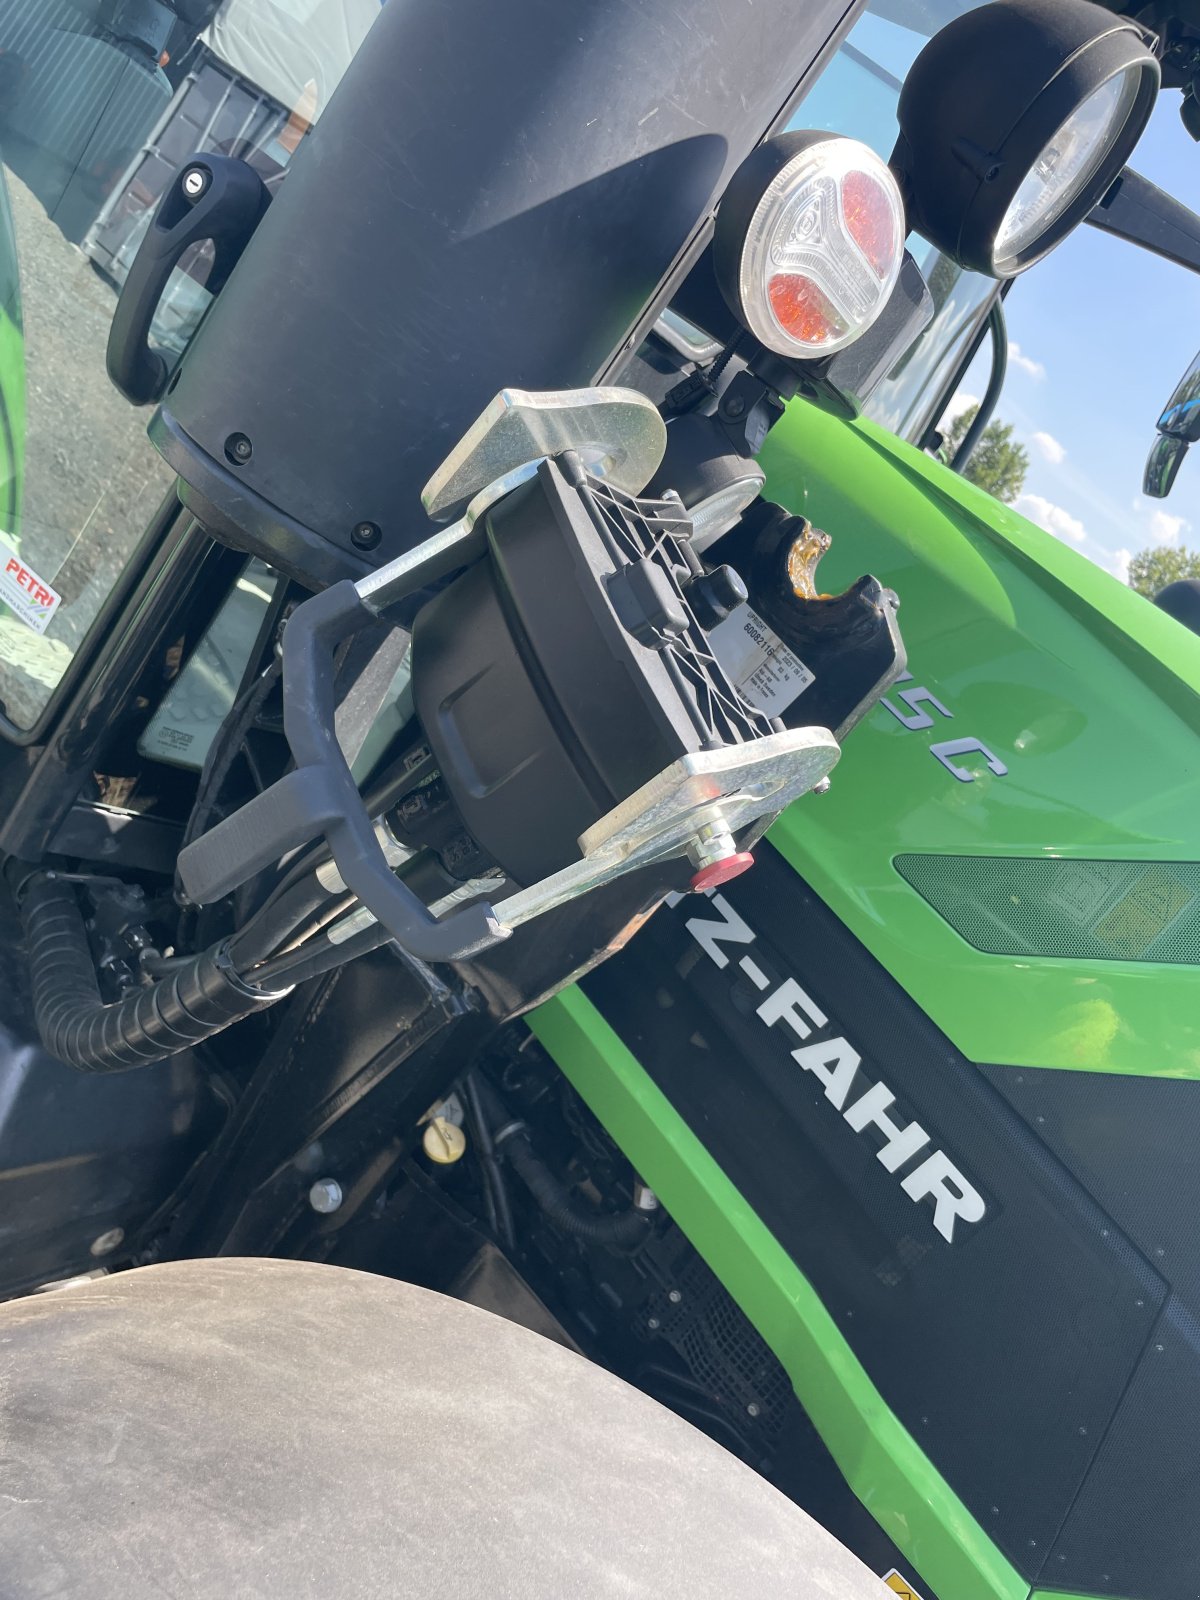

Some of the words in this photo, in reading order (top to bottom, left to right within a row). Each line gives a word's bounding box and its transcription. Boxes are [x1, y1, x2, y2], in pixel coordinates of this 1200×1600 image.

[6, 558, 55, 607] PETRI
[0, 588, 40, 629] ANDMASCHINEN
[747, 611, 768, 632] UPRIGHT
[743, 623, 775, 656] 60082116
[880, 671, 954, 731] 5
[666, 888, 986, 1243] Z-FAHR
